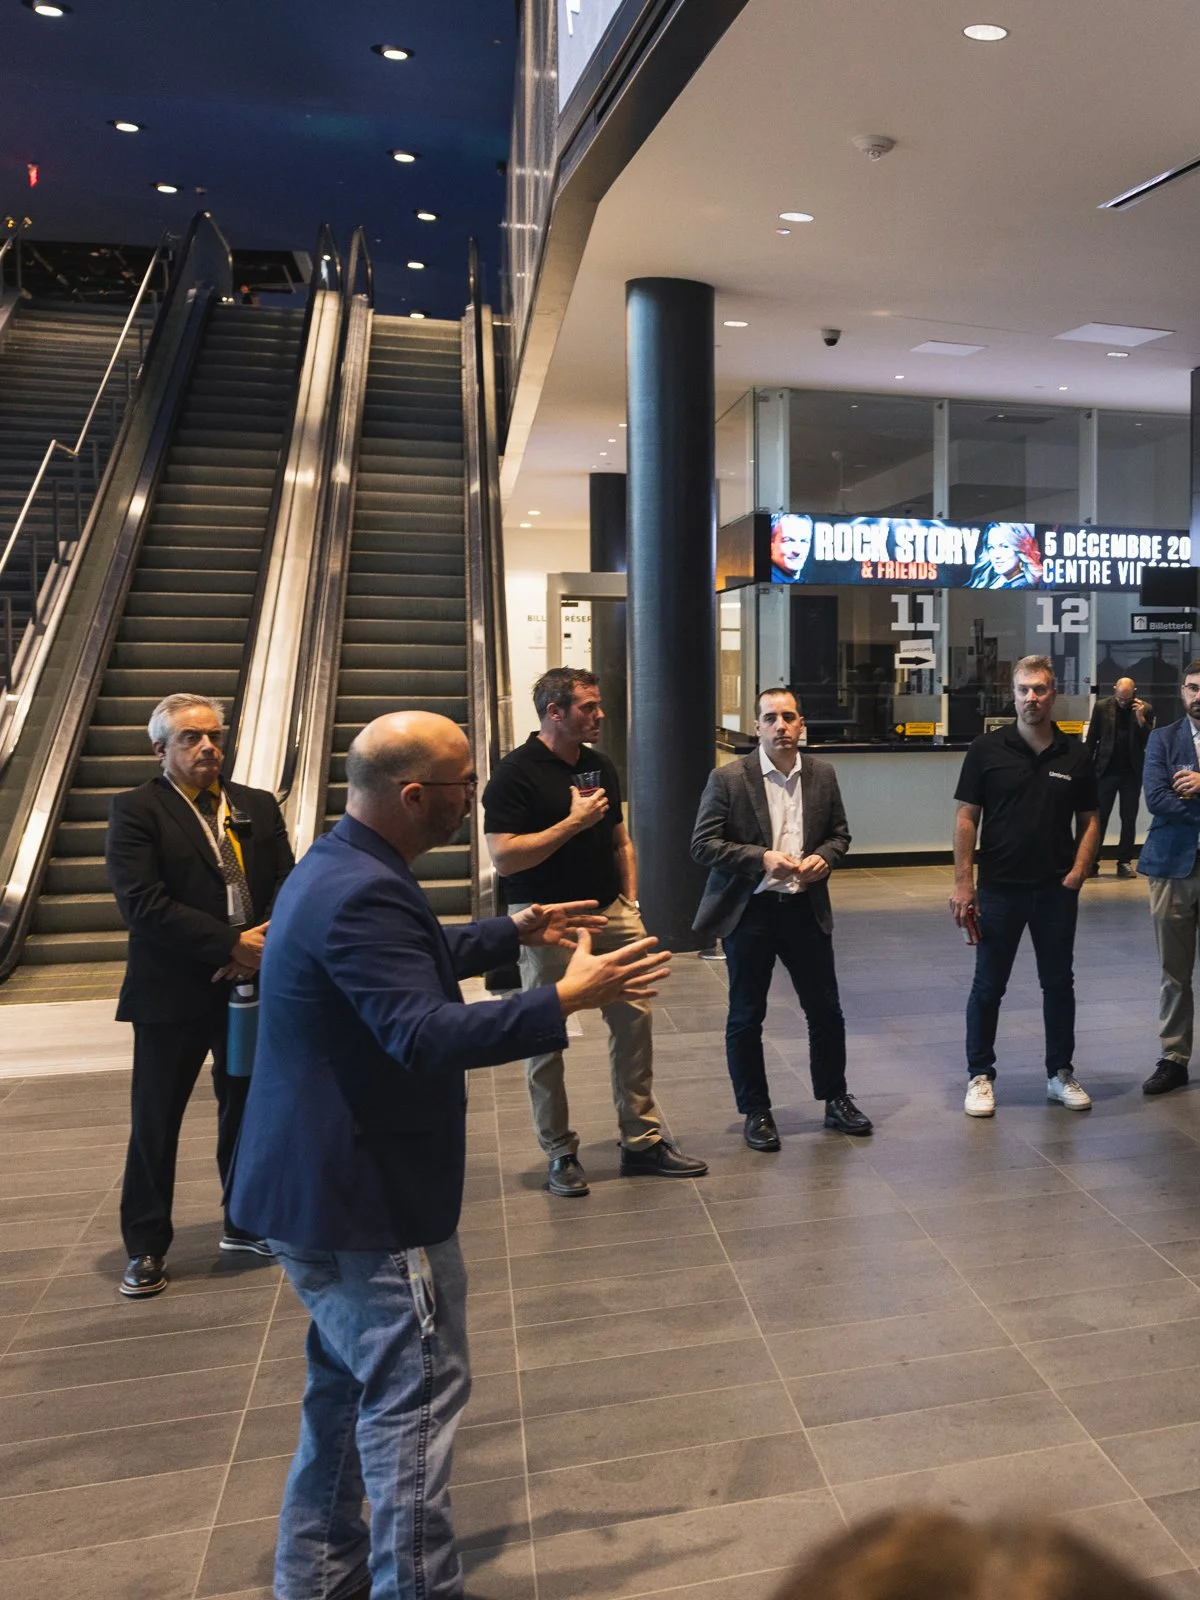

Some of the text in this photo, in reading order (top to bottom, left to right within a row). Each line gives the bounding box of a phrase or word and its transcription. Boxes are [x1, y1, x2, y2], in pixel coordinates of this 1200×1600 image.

[814, 522, 980, 565] ROCK STORY
[1044, 530, 1191, 561] 5 DÉCEMBRE 20
[861, 560, 938, 580] & FRIENDS
[1042, 558, 1112, 585] CENTRE
[891, 594, 940, 631] 11
[1036, 597, 1089, 633] 12
[1149, 621, 1193, 631] Billetterie
